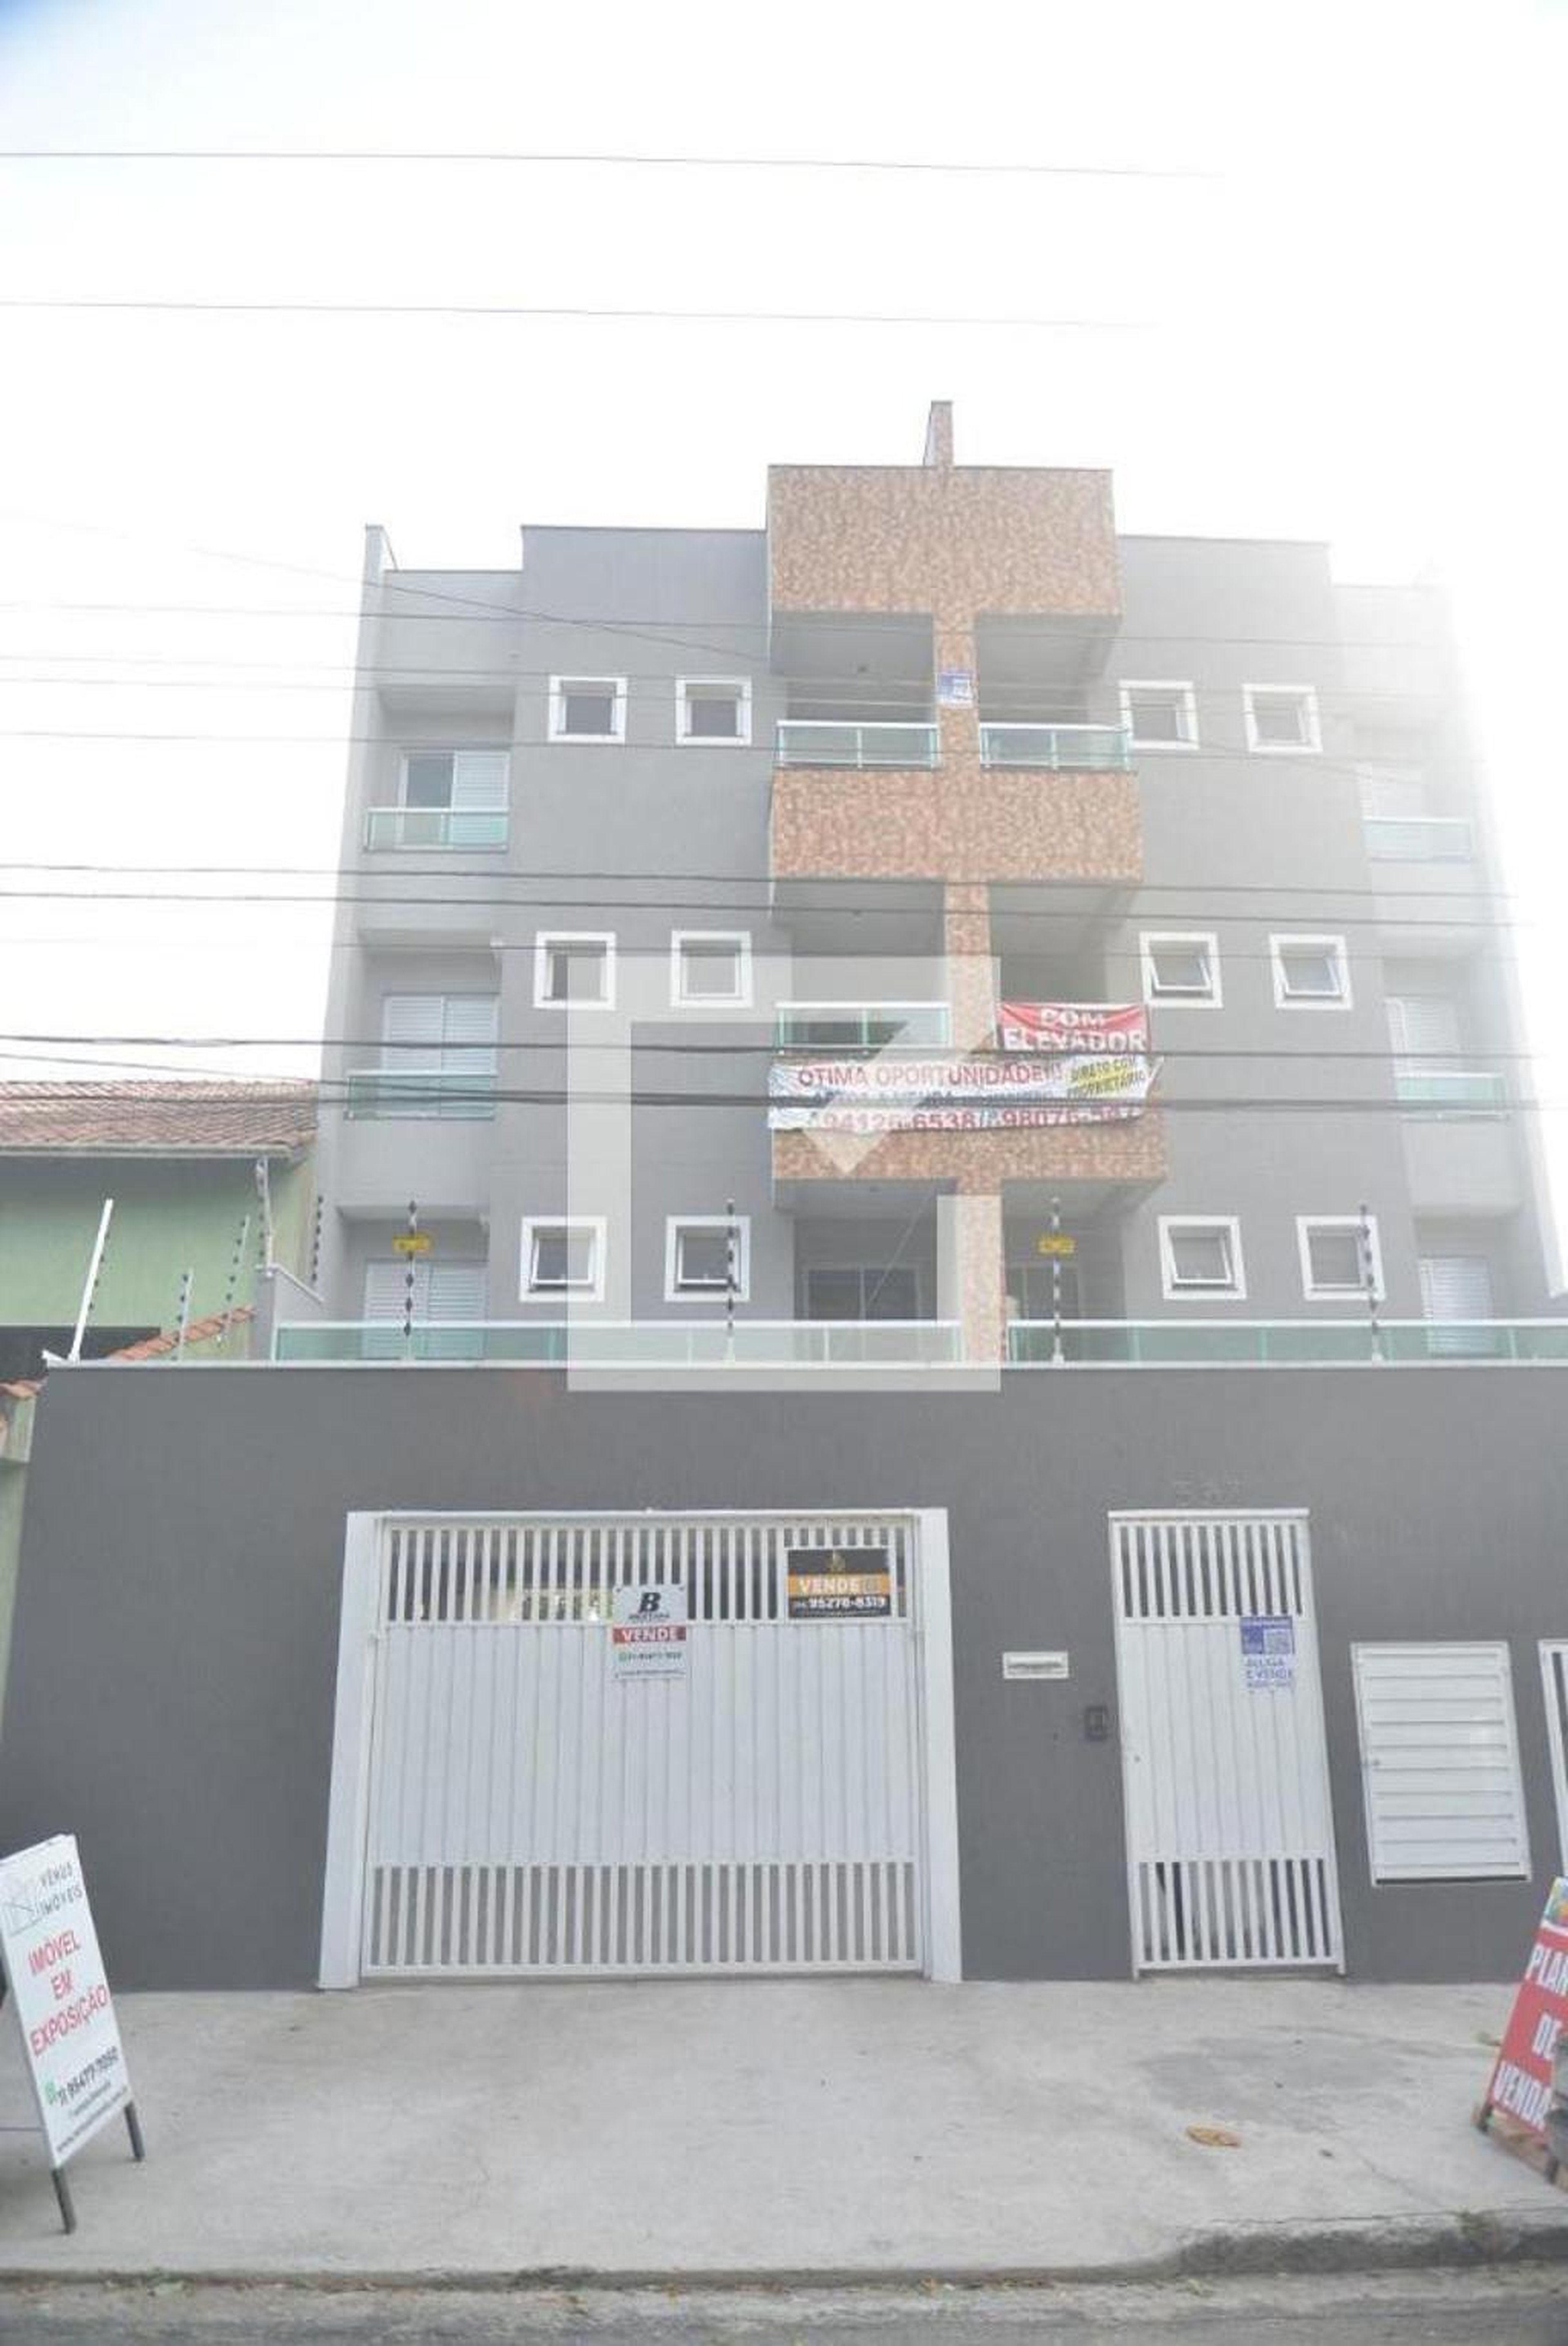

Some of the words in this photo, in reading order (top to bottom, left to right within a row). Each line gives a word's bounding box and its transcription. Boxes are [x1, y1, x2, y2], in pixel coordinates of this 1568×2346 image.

[1003, 1028, 1145, 1052] ELEVADOR
[798, 1575, 861, 1593] VENDE
[637, 1592, 662, 1613] B
[621, 1628, 678, 1642] VENDE
[51, 1969, 74, 2000] EM
